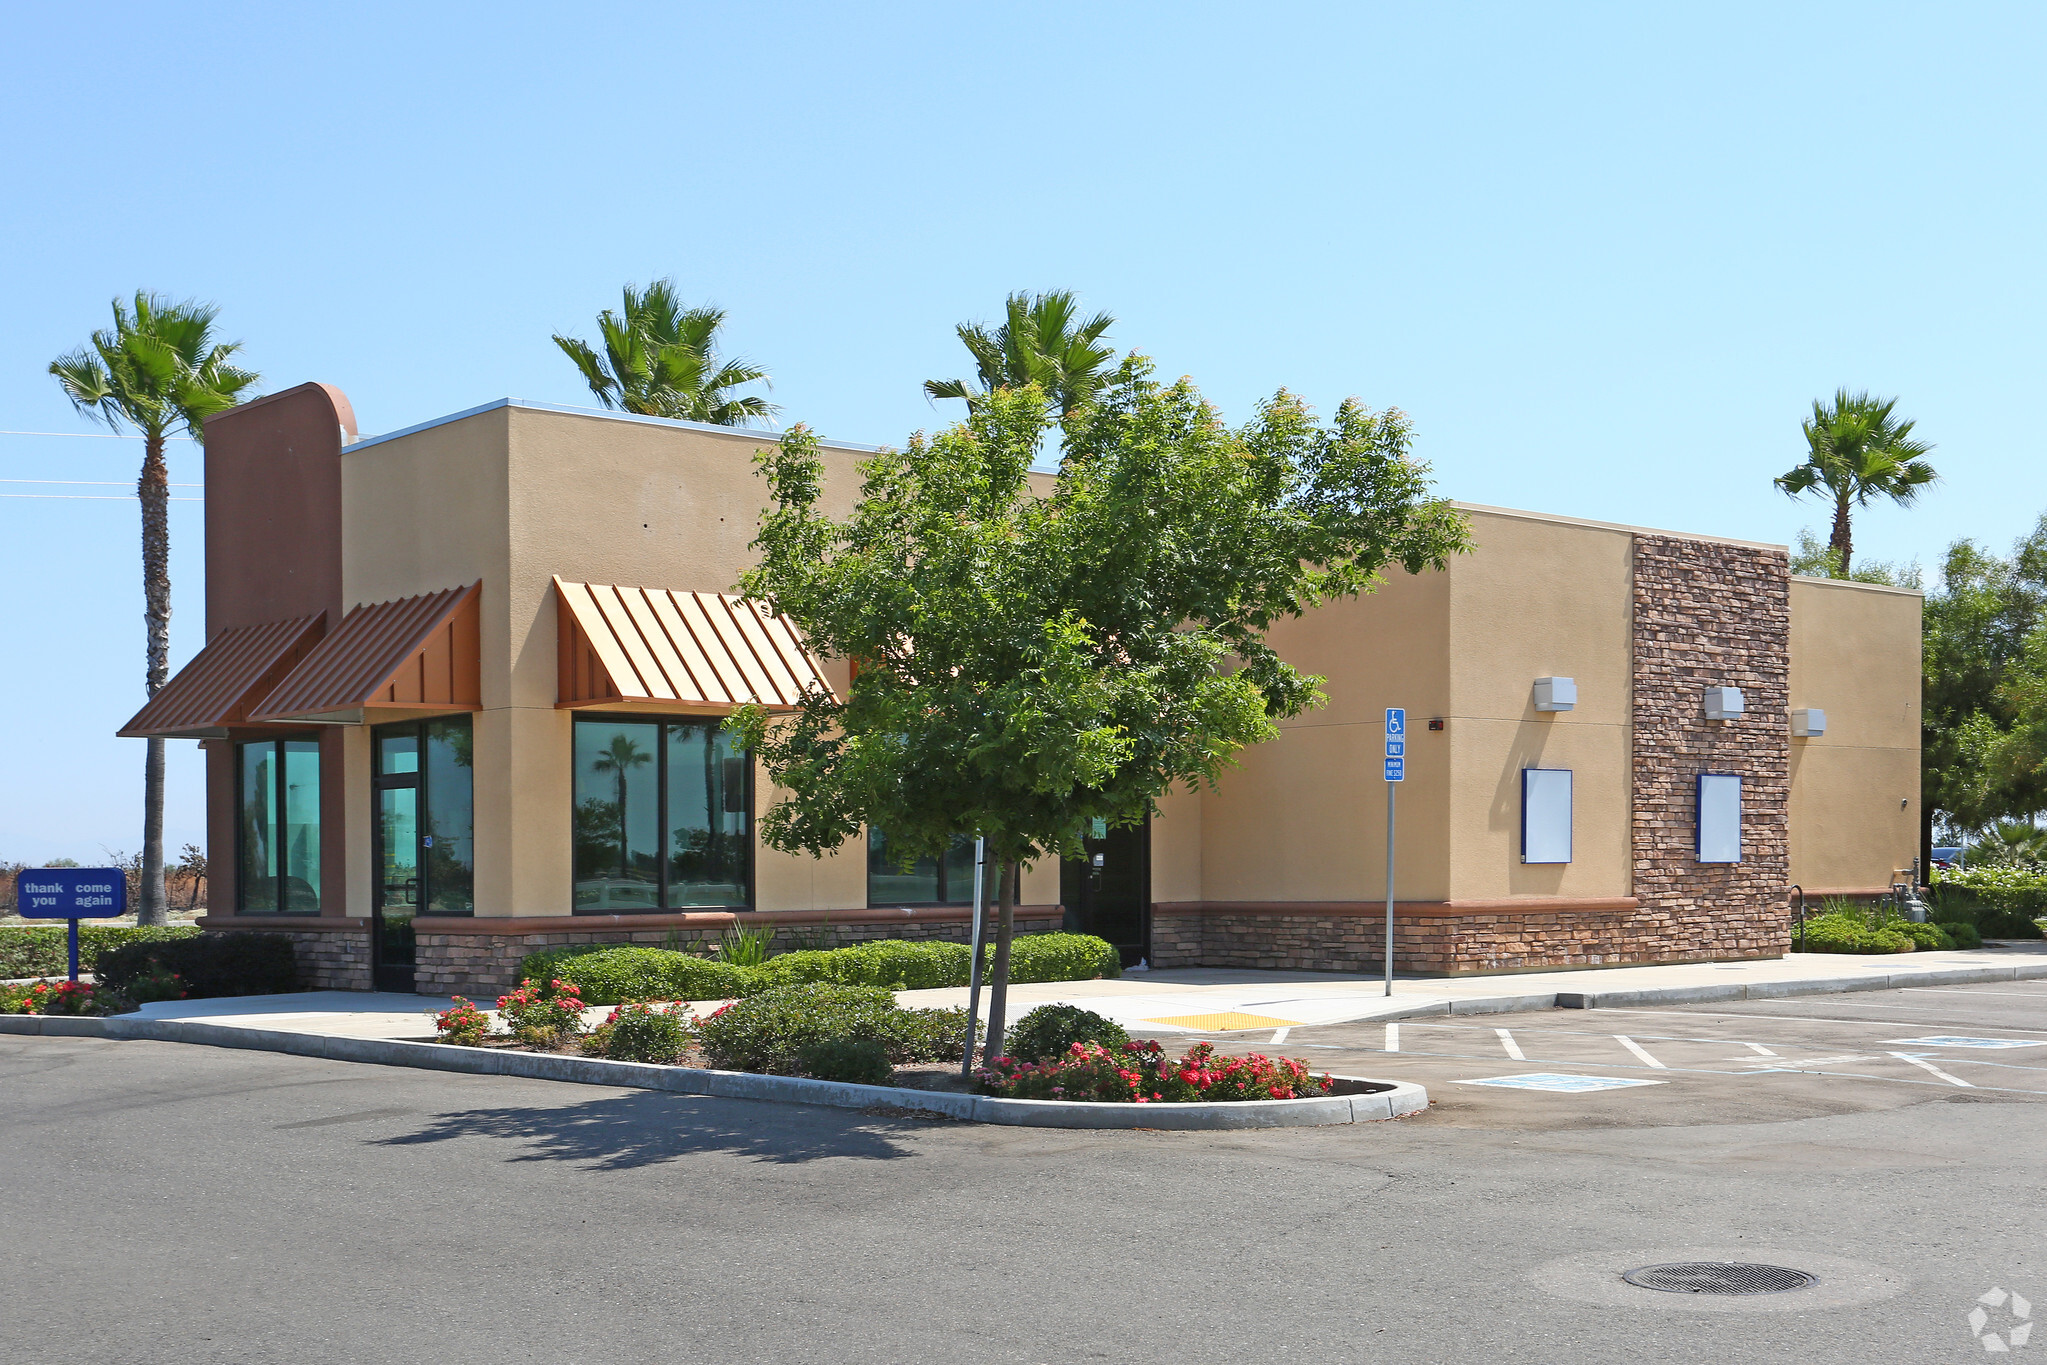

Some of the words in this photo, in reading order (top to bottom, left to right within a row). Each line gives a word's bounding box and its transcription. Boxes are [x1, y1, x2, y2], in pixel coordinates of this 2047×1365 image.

[1386, 733, 1404, 742] PARKING
[1389, 744, 1401, 753] ONLY
[24, 882, 64, 893] thank
[75, 884, 112, 893] come
[32, 897, 57, 908] you
[75, 895, 113, 908] again
